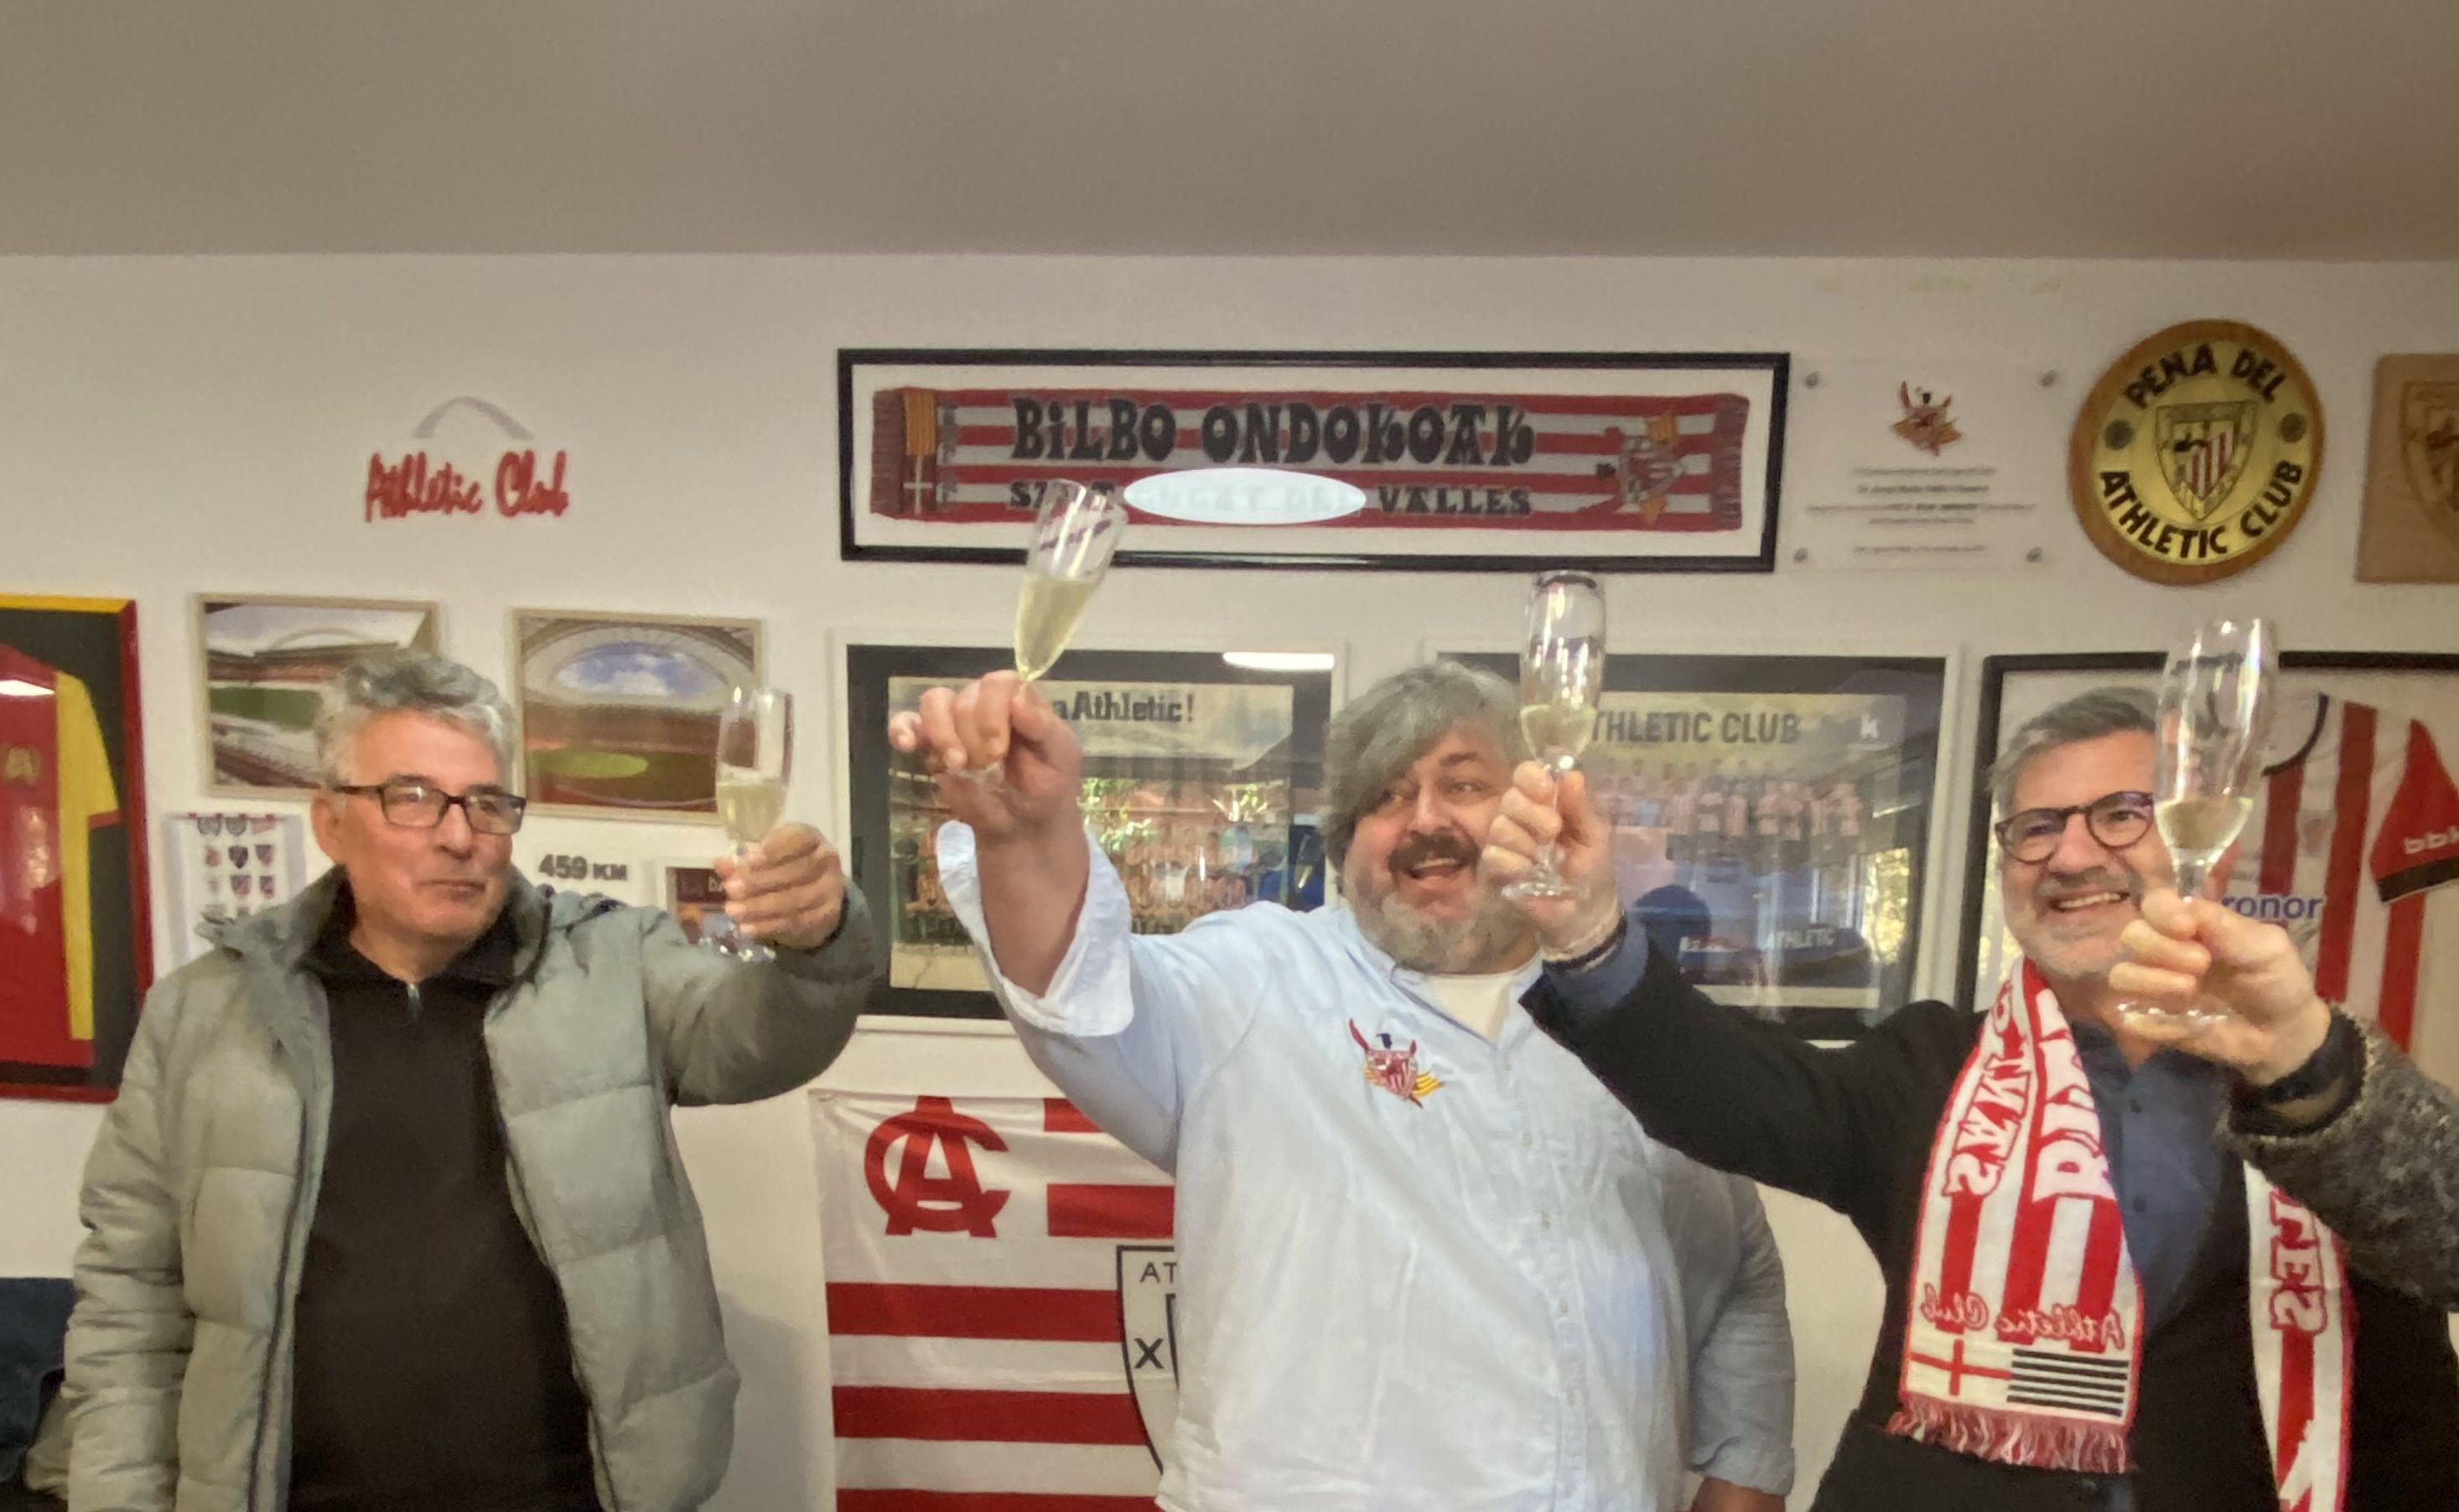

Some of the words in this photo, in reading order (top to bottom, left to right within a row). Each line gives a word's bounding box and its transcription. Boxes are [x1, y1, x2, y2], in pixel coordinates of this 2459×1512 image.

[2231, 348, 2286, 403] DEL
[366, 452, 483, 522] Athletic
[495, 449, 569, 516] Club
[1378, 485, 1531, 517] VALLES
[2100, 470, 2228, 558] ATHLETIC
[2240, 461, 2302, 538] CLUB
[1071, 691, 1195, 722] Athletic!
[1721, 712, 1801, 743] CLUB
